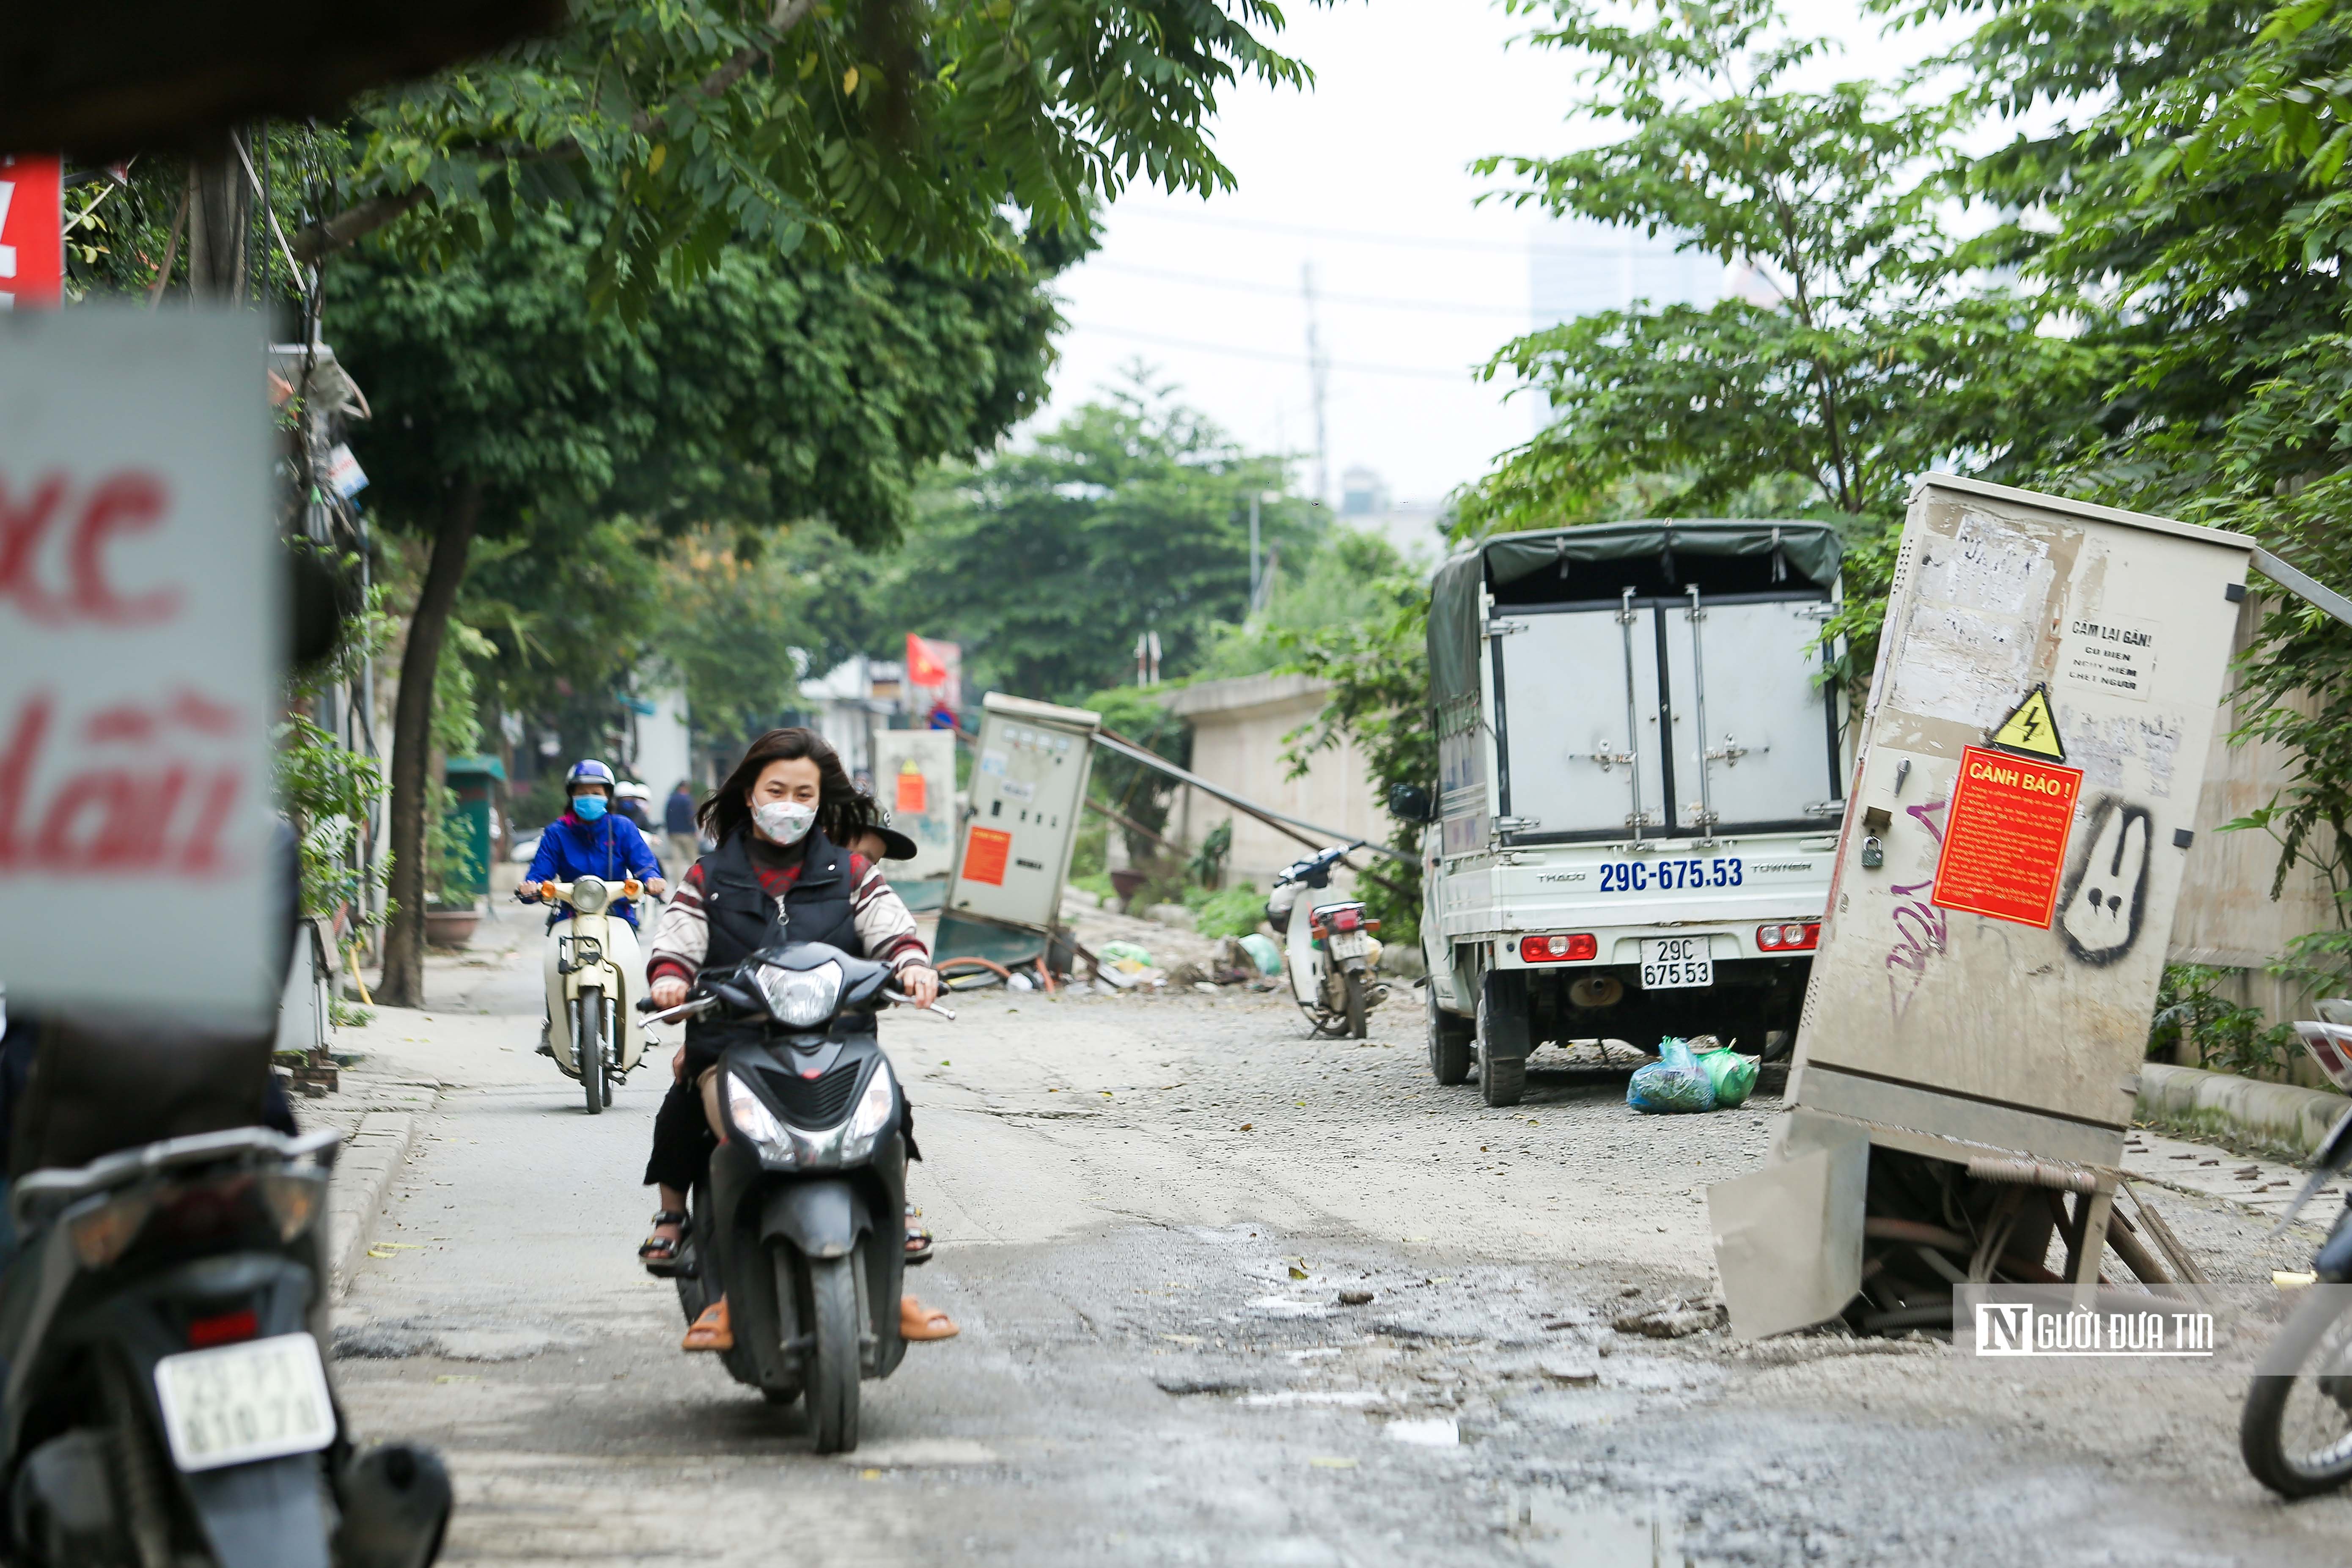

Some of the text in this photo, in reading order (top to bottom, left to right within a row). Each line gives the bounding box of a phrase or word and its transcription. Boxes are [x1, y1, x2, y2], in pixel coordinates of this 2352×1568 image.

[1969, 761, 2020, 788] CẢNH
[2022, 772, 2061, 796] BÁO
[1536, 871, 1585, 883] THACO
[1600, 858, 1742, 892] 29C-675.53
[1750, 861, 1812, 874] TOWNER
[1657, 939, 1693, 961] 29C
